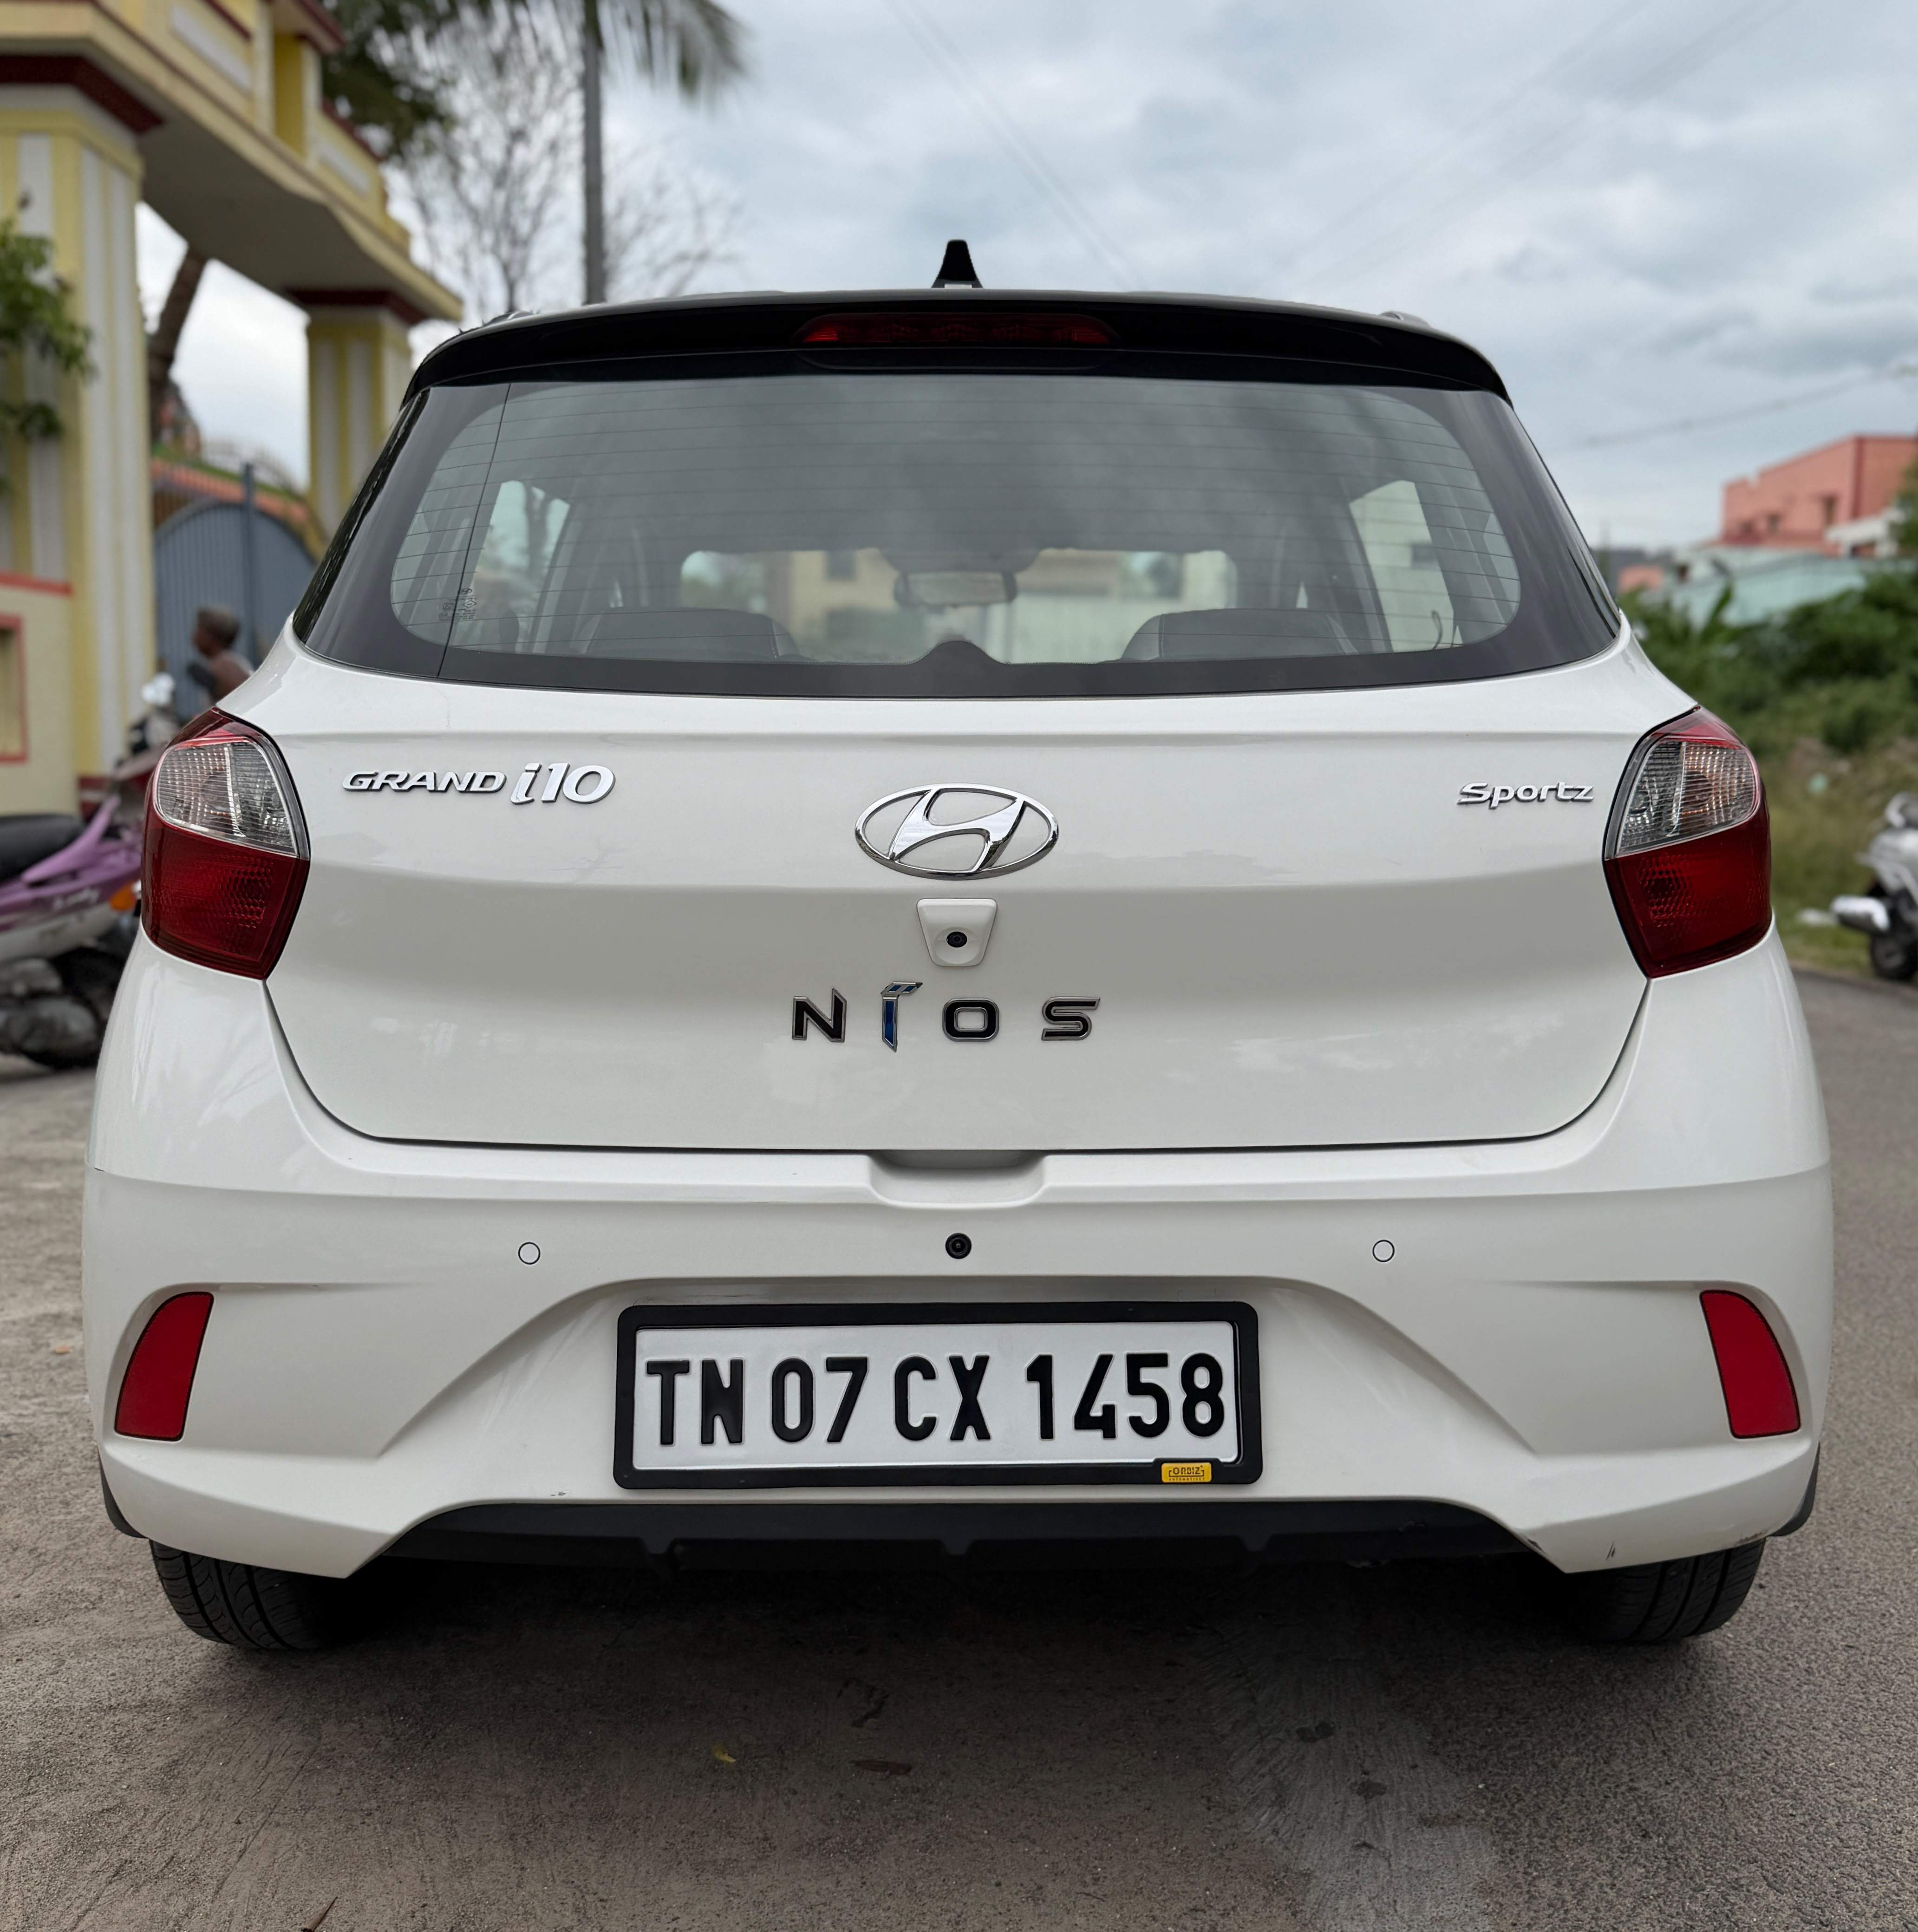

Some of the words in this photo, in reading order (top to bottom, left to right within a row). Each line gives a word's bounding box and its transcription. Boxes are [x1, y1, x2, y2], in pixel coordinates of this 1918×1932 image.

[342, 770, 507, 792] GRAND
[510, 762, 615, 804] i10
[1456, 782, 1595, 809] Sportz
[646, 1358, 744, 1446] TN
[770, 1357, 868, 1443] 07
[894, 1355, 992, 1442] CX
[1026, 1352, 1225, 1440] 1458
